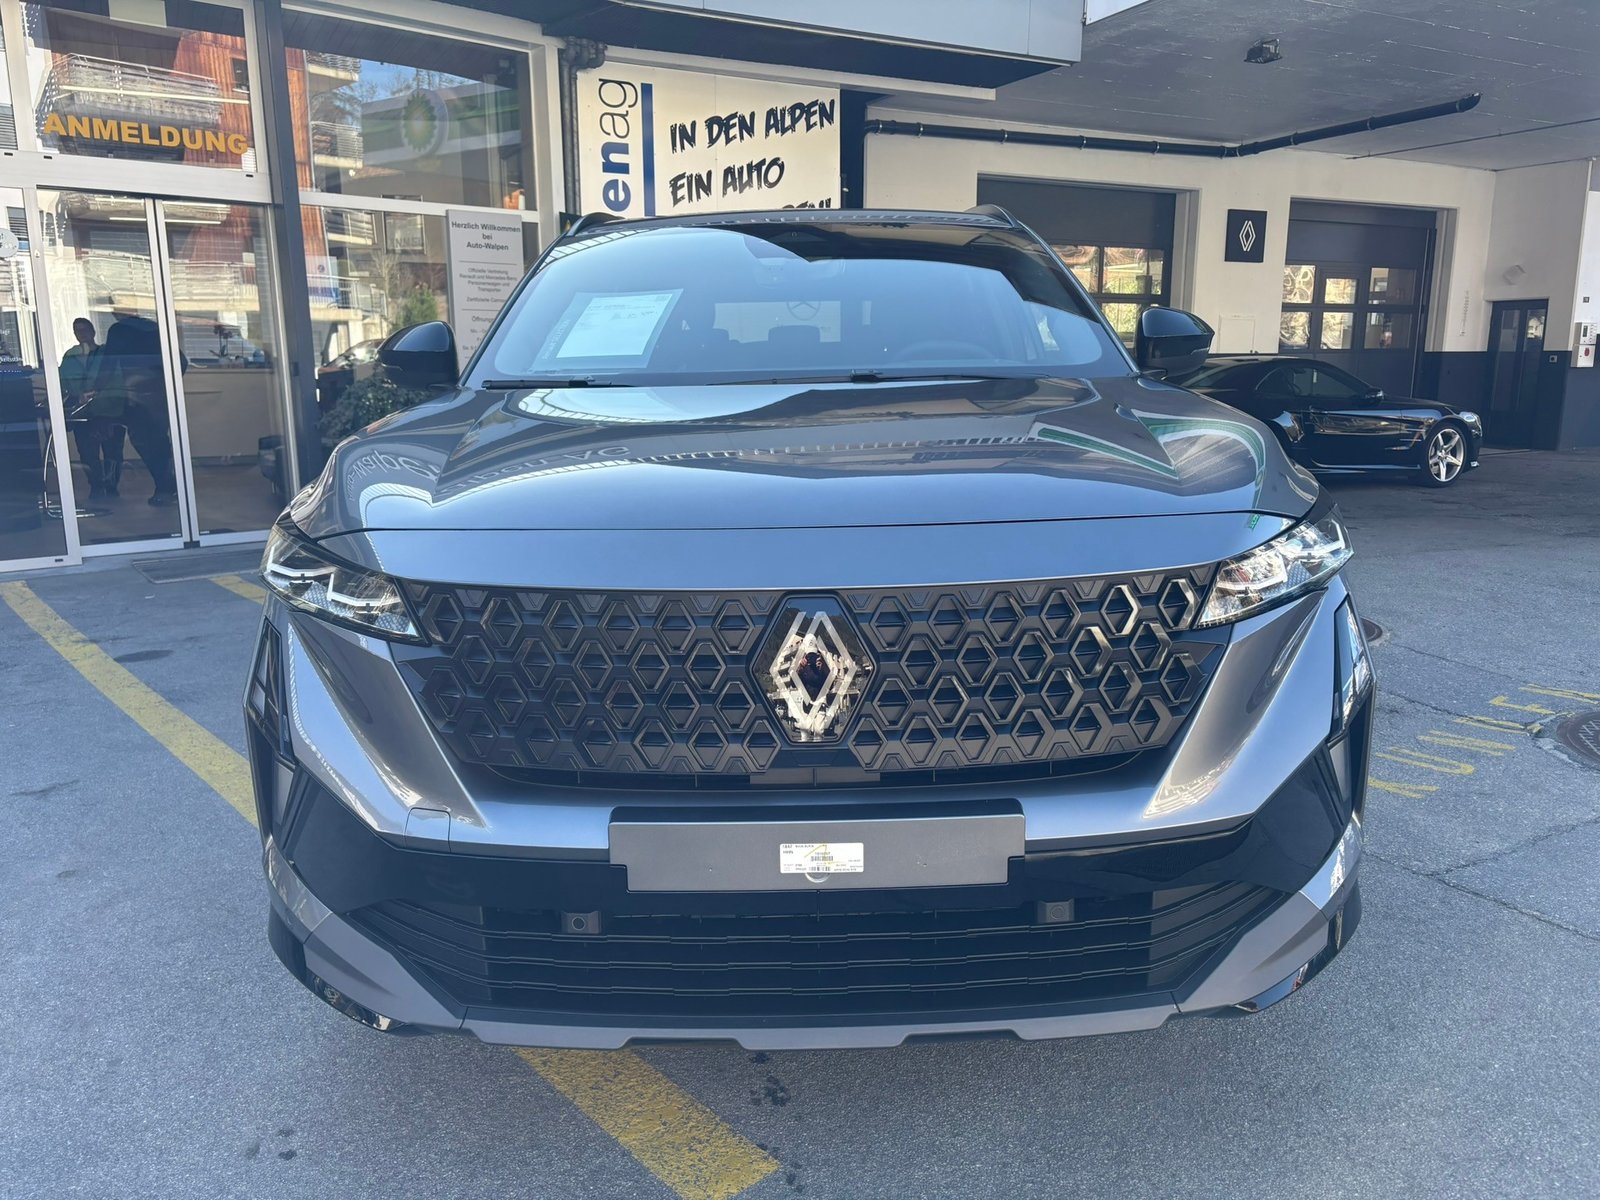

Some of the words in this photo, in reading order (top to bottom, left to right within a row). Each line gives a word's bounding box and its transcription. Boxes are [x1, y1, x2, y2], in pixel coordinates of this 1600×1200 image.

[43, 112, 249, 155] ANMELDUNG
[670, 120, 697, 154] IN
[704, 111, 755, 148] DEN
[764, 99, 835, 139] ALPEN
[669, 170, 712, 207] EIN
[722, 157, 785, 198] AUTO
[451, 221, 480, 230] Herzlich
[480, 223, 521, 233] Willkommen
[466, 241, 509, 251] Auto-Walpen
